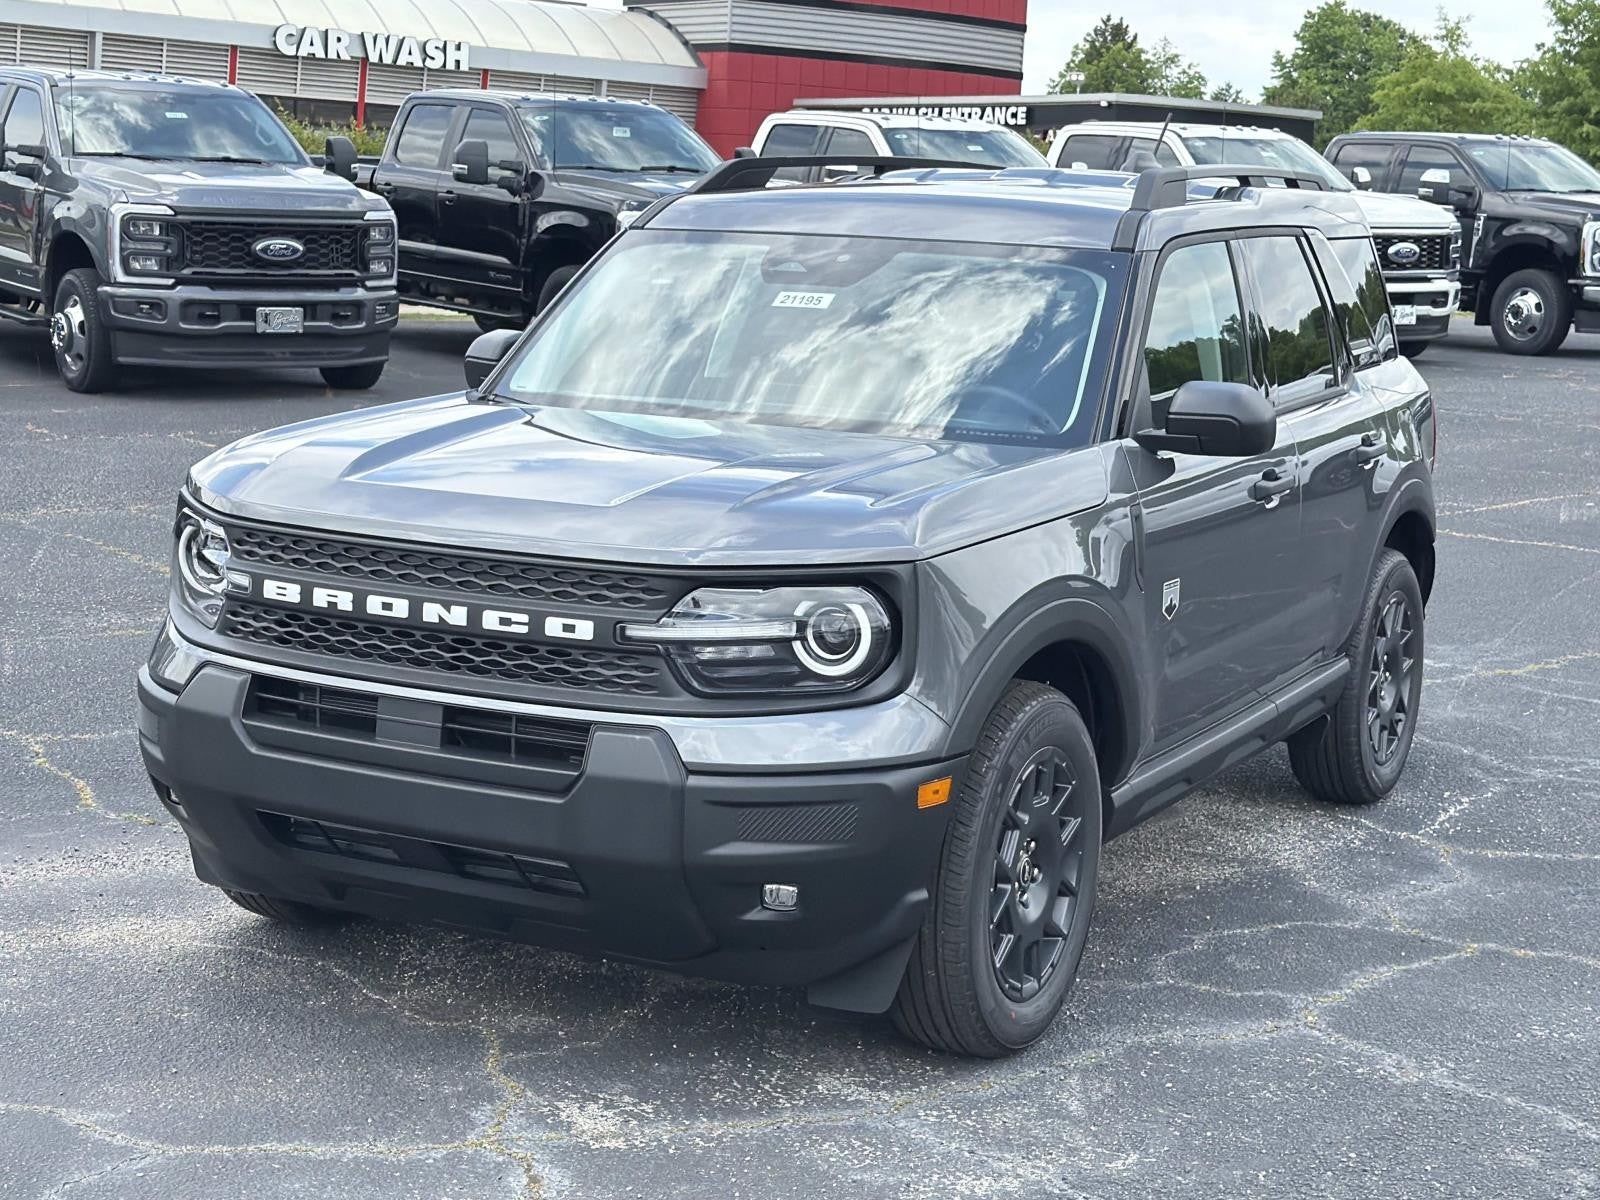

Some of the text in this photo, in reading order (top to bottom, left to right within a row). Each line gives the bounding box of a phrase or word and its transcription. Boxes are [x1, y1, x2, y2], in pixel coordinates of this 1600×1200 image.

[274, 23, 471, 71] CAR WASH
[942, 106, 1027, 125] ENTRANCE
[267, 244, 293, 256] Ford
[779, 294, 824, 306] 21195
[262, 579, 595, 641] BRONCO
